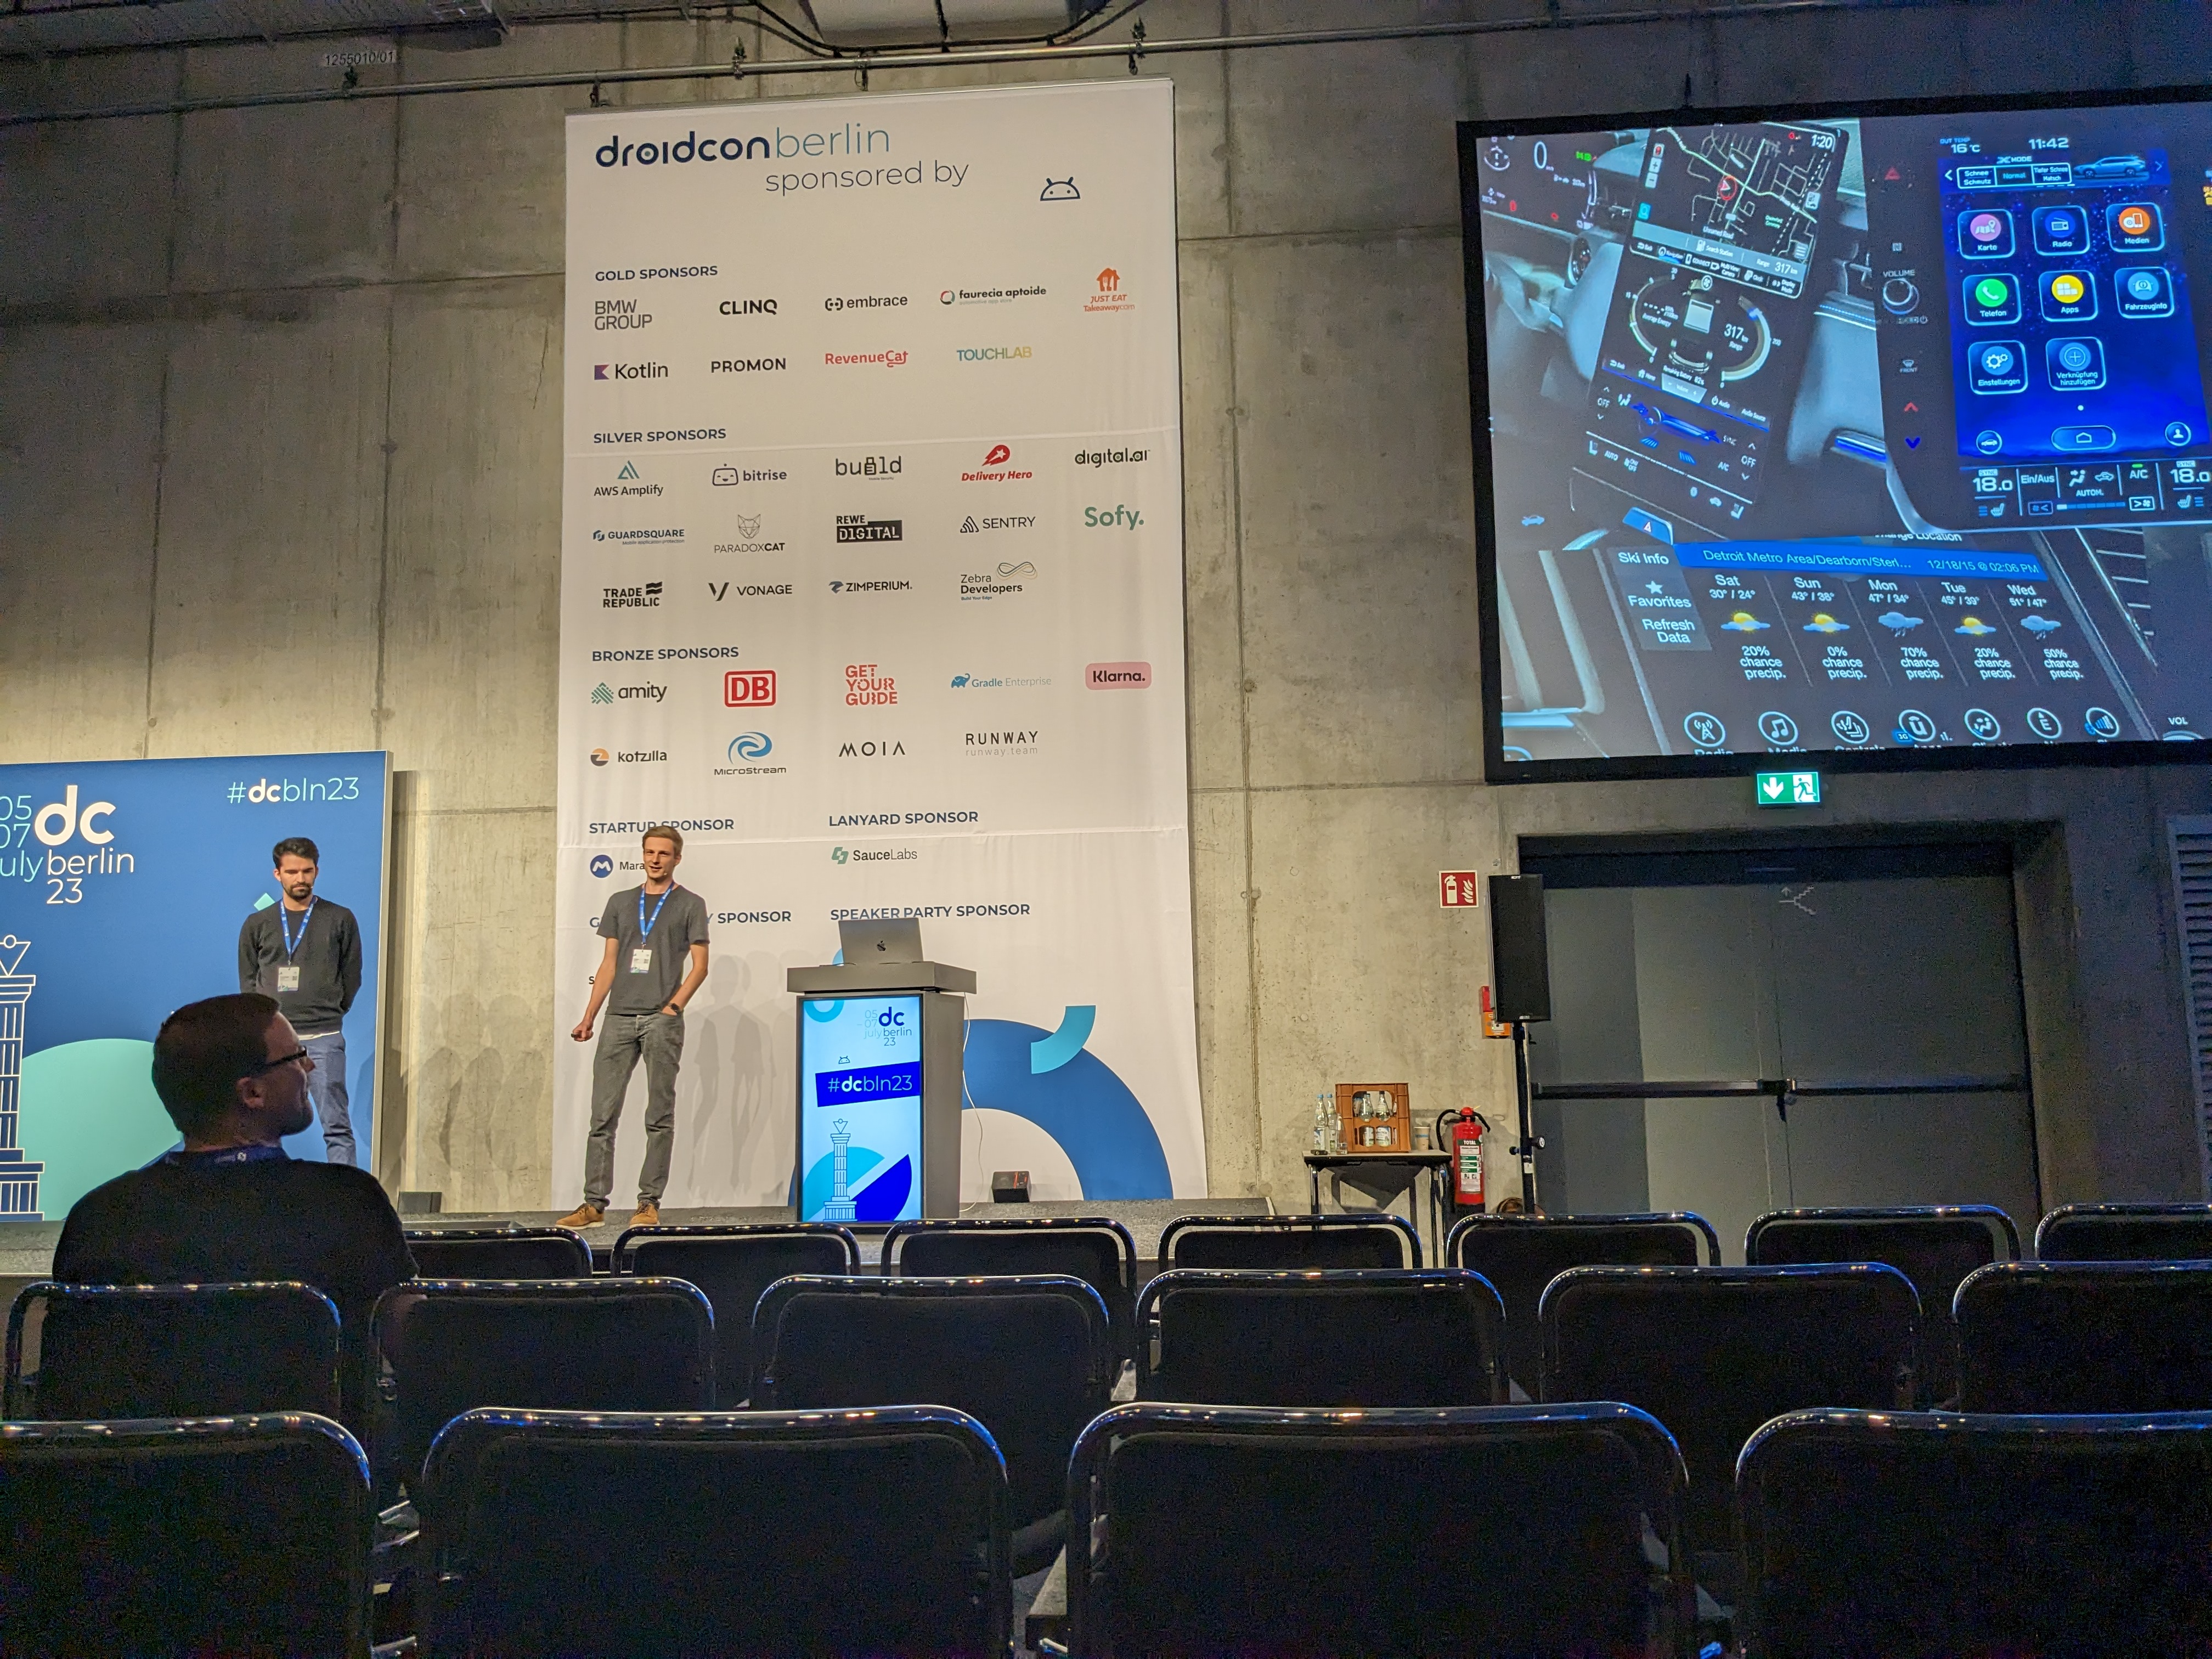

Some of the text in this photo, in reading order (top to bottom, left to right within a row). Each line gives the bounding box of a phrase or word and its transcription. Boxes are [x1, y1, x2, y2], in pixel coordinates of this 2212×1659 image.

[1812, 134, 1833, 149] 1:20
[2028, 138, 2069, 149] 11:42
[1951, 144, 1967, 154] 16
[766, 160, 969, 196] sponsored by
[595, 266, 718, 281] GOLD SPONSORS
[1775, 262, 1791, 274] 317
[959, 286, 1047, 299] faurecia aptoide
[847, 296, 908, 308] embrace
[1090, 295, 1110, 303] JUST
[595, 299, 637, 315] BMW
[719, 299, 777, 315] CLINQ
[2061, 306, 2079, 314] Apps
[2125, 302, 2168, 312] Fahrzeuginfo
[595, 314, 652, 330] GROUP
[1724, 323, 1743, 339] 317
[825, 350, 909, 368] RevenueCat
[956, 346, 1032, 362] TOUCHLAB
[615, 362, 669, 380] Kotlin
[711, 358, 786, 374] PROMON
[2057, 371, 2098, 380] Verknüpfung
[1978, 378, 2021, 386] Einstellungen
[1597, 398, 1611, 408] OFF
[593, 428, 727, 444] SILVER SPONSORS
[1075, 447, 1148, 468] digital.ai
[1741, 455, 1757, 467] OFF
[743, 469, 787, 482] bitrise
[961, 470, 1032, 482] Delivery Hero
[2021, 474, 2055, 484] Ein/Aus
[2130, 470, 2148, 480] A/C
[2170, 469, 2210, 484] 18.0
[594, 484, 664, 498] AWS Amplify
[1973, 477, 2013, 493] 18.0
[836, 515, 865, 524] REWE
[983, 516, 1036, 529] SENTRY
[1084, 505, 1144, 531] Sofy.
[608, 529, 685, 540] GUARDSQUARE
[714, 543, 785, 554] PARADOXCAT
[1618, 552, 1669, 565] Ski Info
[1703, 550, 1745, 562] Detroit
[1747, 552, 1783, 563] Metro
[1927, 558, 1976, 572] 12/18/15
[1989, 562, 2019, 573] 02:06
[2020, 563, 2040, 574] PM
[961, 574, 991, 584] Zebra
[1715, 574, 1740, 587] Sat
[1793, 577, 1821, 589] Sun
[736, 585, 793, 596] VONAGE
[960, 584, 1023, 595] Developers
[1869, 579, 1898, 592] Mon
[1941, 582, 1966, 594] Tue
[2007, 584, 2038, 596] Wed
[603, 588, 642, 598] TRADE
[603, 597, 660, 608] REPUBLIC
[1628, 595, 1692, 608] Favorites
[1643, 619, 1695, 631] Refresh
[1658, 631, 1691, 644] Data
[592, 647, 739, 662] BRONZE SPONSORS
[1741, 646, 1770, 657] 20%
[1827, 646, 1848, 657] 0%
[1900, 647, 1927, 657] 70%
[1974, 647, 1999, 658] 20%
[2044, 648, 2068, 658] 50%
[1740, 657, 1782, 668] chance
[1822, 657, 1863, 668] chance
[1900, 657, 1939, 669] chance
[1974, 658, 2011, 669] chance
[2044, 658, 2079, 669] chance
[845, 664, 878, 678] GET
[1092, 670, 1146, 684] Klarna.
[1744, 668, 1786, 680] precip.
[1827, 668, 1867, 680] precip.
[1905, 669, 1944, 680] precip.
[1979, 669, 2016, 680] precip.
[2050, 669, 2084, 680] precip.
[846, 678, 895, 692] YOUR
[972, 676, 1052, 687] Gradle Enterprise
[618, 681, 668, 703] amity
[731, 676, 771, 701] DB
[845, 692, 898, 706] GUIDE
[2168, 717, 2188, 726] VOL
[966, 731, 1039, 746] RUNWAY
[839, 741, 906, 758] MOIA
[966, 746, 1038, 757] runway.team
[618, 750, 667, 764] kotzilla
[714, 766, 787, 775] MicroStream
[227, 777, 359, 804] #dcbln23
[35, 785, 116, 845] dc
[829, 811, 979, 827] LANYARD SPONSOR
[853, 848, 918, 862] SauceLabs
[0, 850, 43, 882] uly
[48, 848, 134, 875] berlin
[47, 878, 82, 904] 23
[717, 911, 792, 924] SPONSOR
[830, 904, 1031, 921] SPEAKER PARTY SPONSOR
[865, 1010, 878, 1018] 05
[878, 1007, 905, 1026] dc
[864, 1028, 882, 1039] july
[883, 1028, 912, 1036] berlin
[884, 1037, 896, 1046] 23
[828, 1075, 912, 1092] #dcbln23
